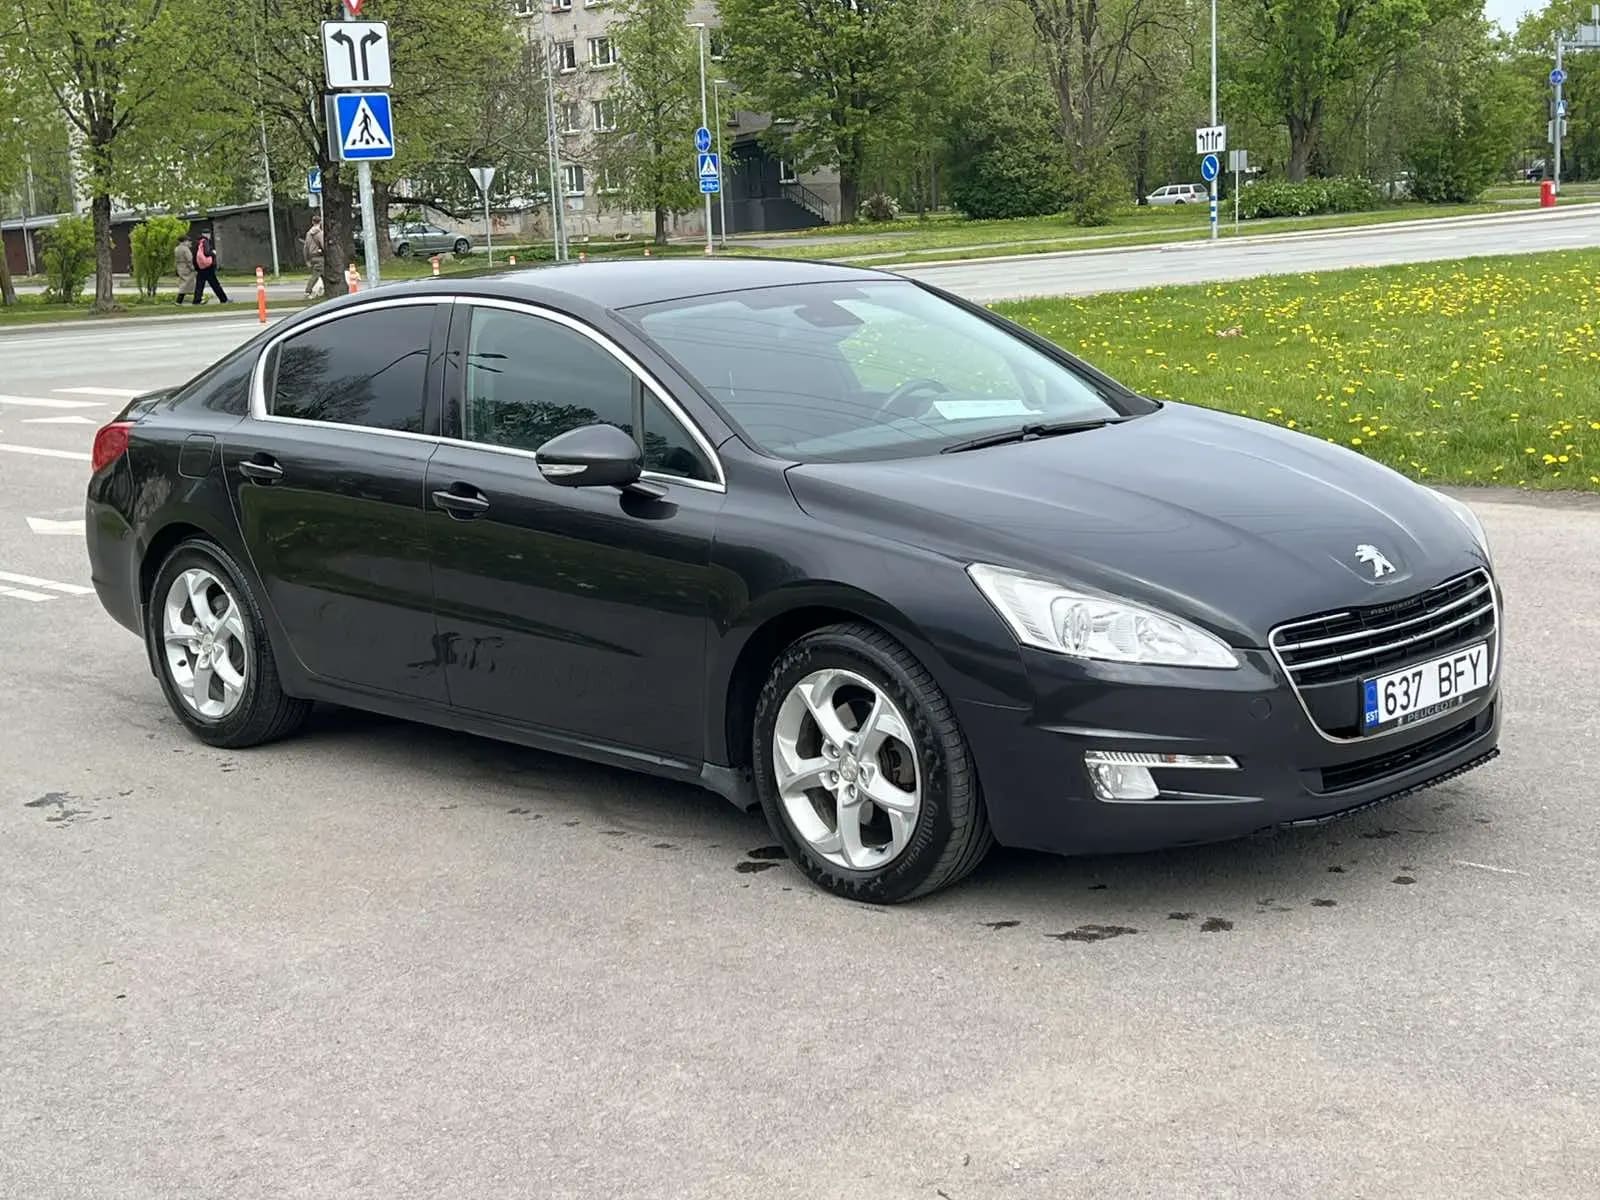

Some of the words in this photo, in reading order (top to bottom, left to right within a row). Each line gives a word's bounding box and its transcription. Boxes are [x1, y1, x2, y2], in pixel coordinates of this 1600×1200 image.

[1384, 670, 1424, 715] 637
[1438, 650, 1482, 698] BFY
[1366, 709, 1379, 723] EST
[1407, 699, 1455, 723] PEUGEOT
